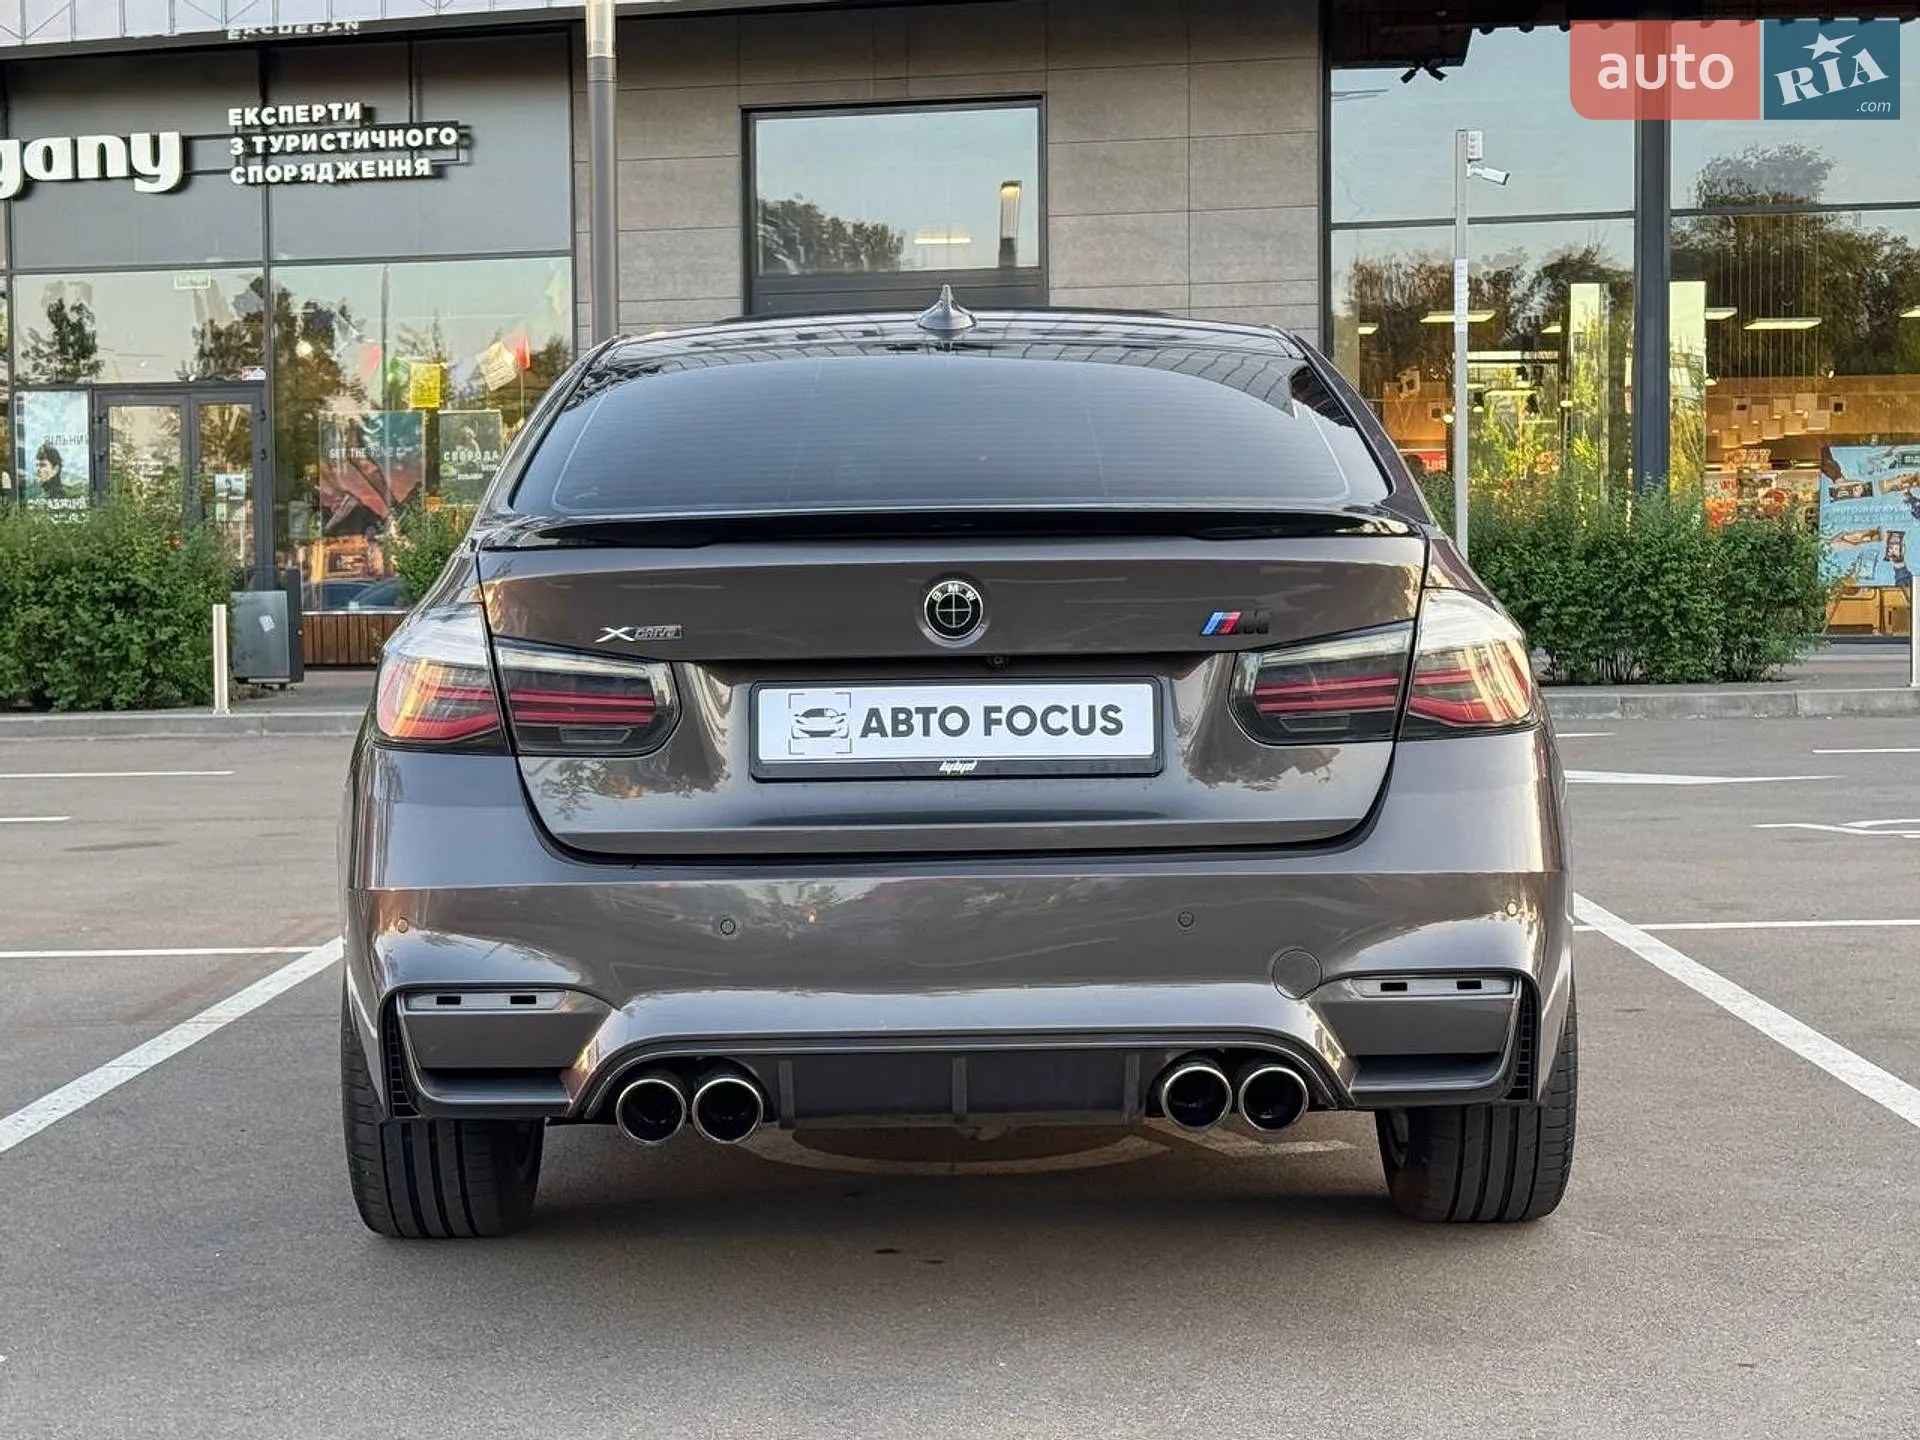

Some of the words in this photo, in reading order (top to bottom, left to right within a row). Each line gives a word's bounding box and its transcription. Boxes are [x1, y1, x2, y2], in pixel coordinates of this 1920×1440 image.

[228, 102, 362, 126] ЕКСПЕРТИ
[230, 137, 244, 156] З
[251, 127, 459, 154] ТУРИСТИЧНОГО
[230, 158, 431, 185] СПОРЯДЖЕННЯ
[931, 583, 978, 601] BMW
[984, 704, 1124, 737] FOCUS
